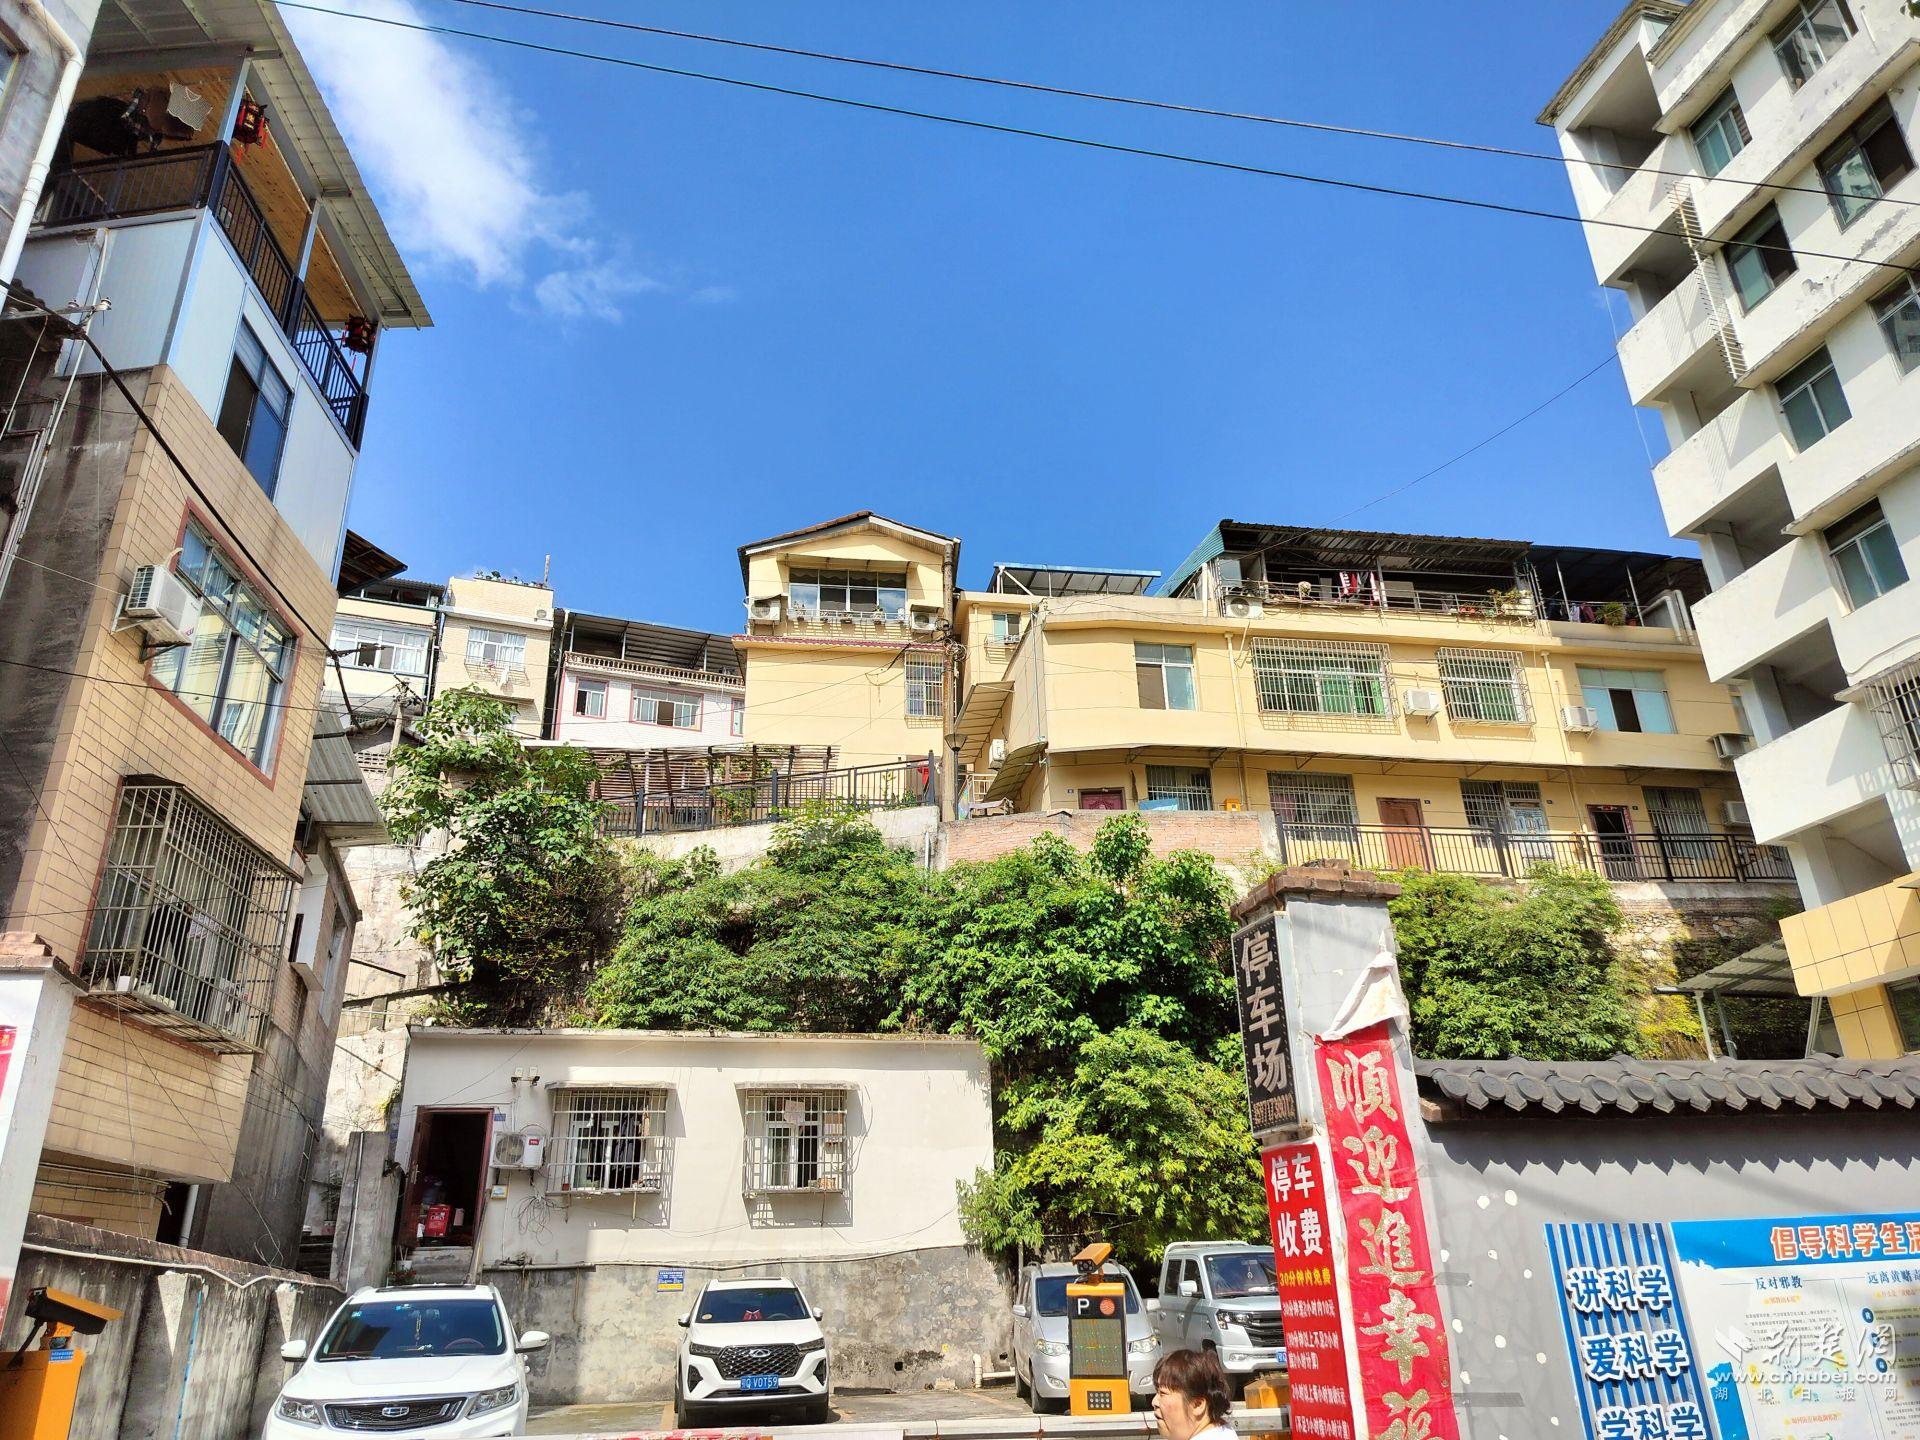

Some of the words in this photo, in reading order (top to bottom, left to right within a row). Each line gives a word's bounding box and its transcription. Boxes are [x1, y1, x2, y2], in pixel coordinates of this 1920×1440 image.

[1240, 931, 1287, 1093] 停车场
[1271, 1152, 1316, 1203] 停车
[1277, 1208, 1323, 1258] 收费
[1280, 1267, 1331, 1287] 30分钟内免费
[1568, 1266, 1672, 1312] 讲科学
[1755, 1275, 1803, 1290] 反对邪教
[1077, 1298, 1090, 1315] P
[1583, 1332, 1688, 1380] 爱科学
[1599, 1404, 1706, 1440] 学科学
